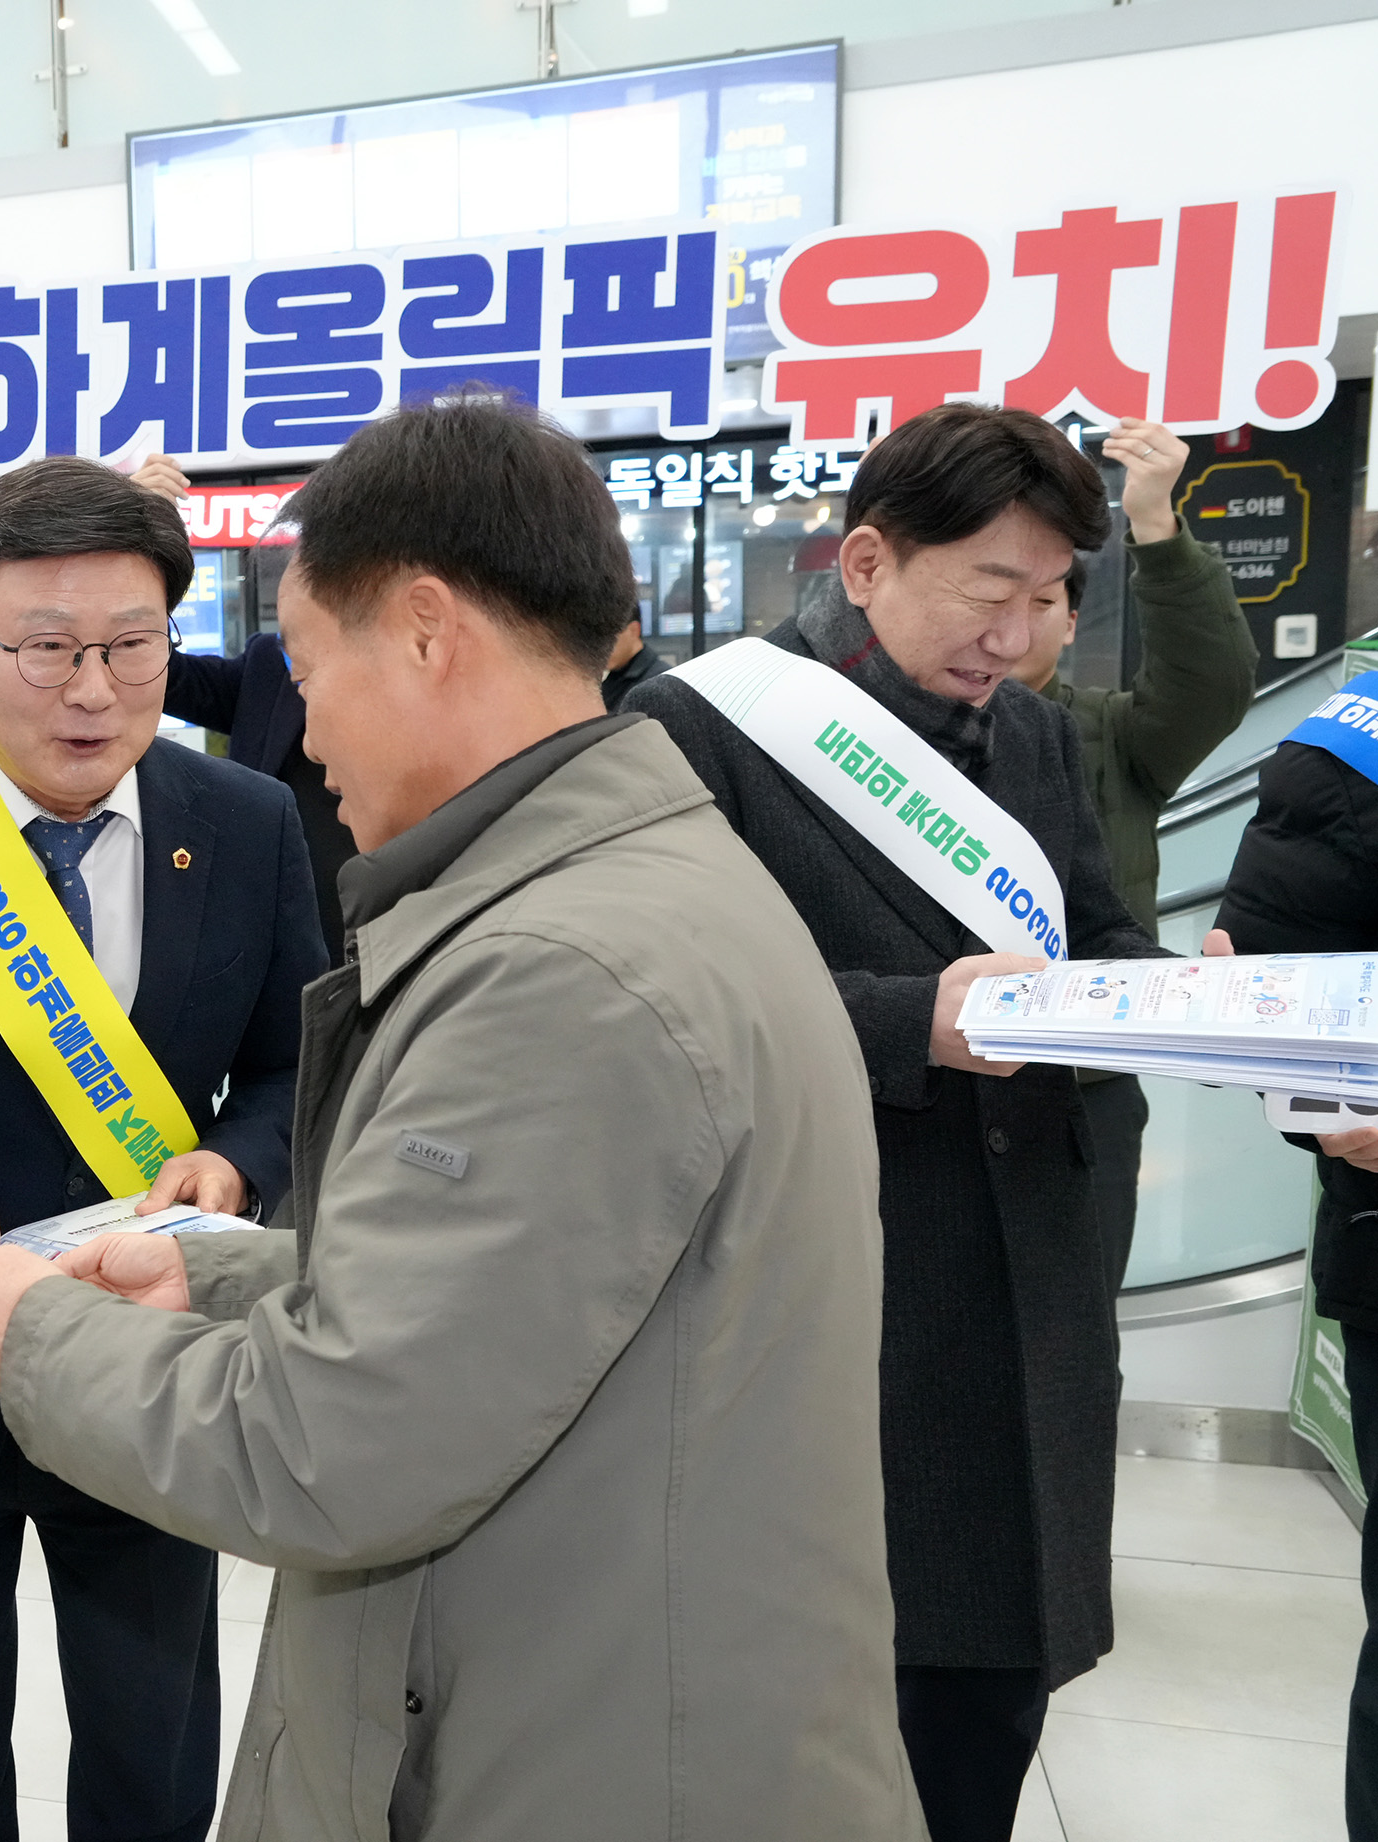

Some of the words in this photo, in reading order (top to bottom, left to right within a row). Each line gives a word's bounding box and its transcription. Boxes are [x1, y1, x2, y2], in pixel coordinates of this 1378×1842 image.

[775, 191, 1337, 440] 유치!
[813, 719, 909, 807] 도민의
[895, 790, 991, 876] 뜻모아
[985, 866, 1063, 961] 2036
[7, 944, 133, 1113] 하계올림픽
[407, 1140, 454, 1166] HAZZYS
